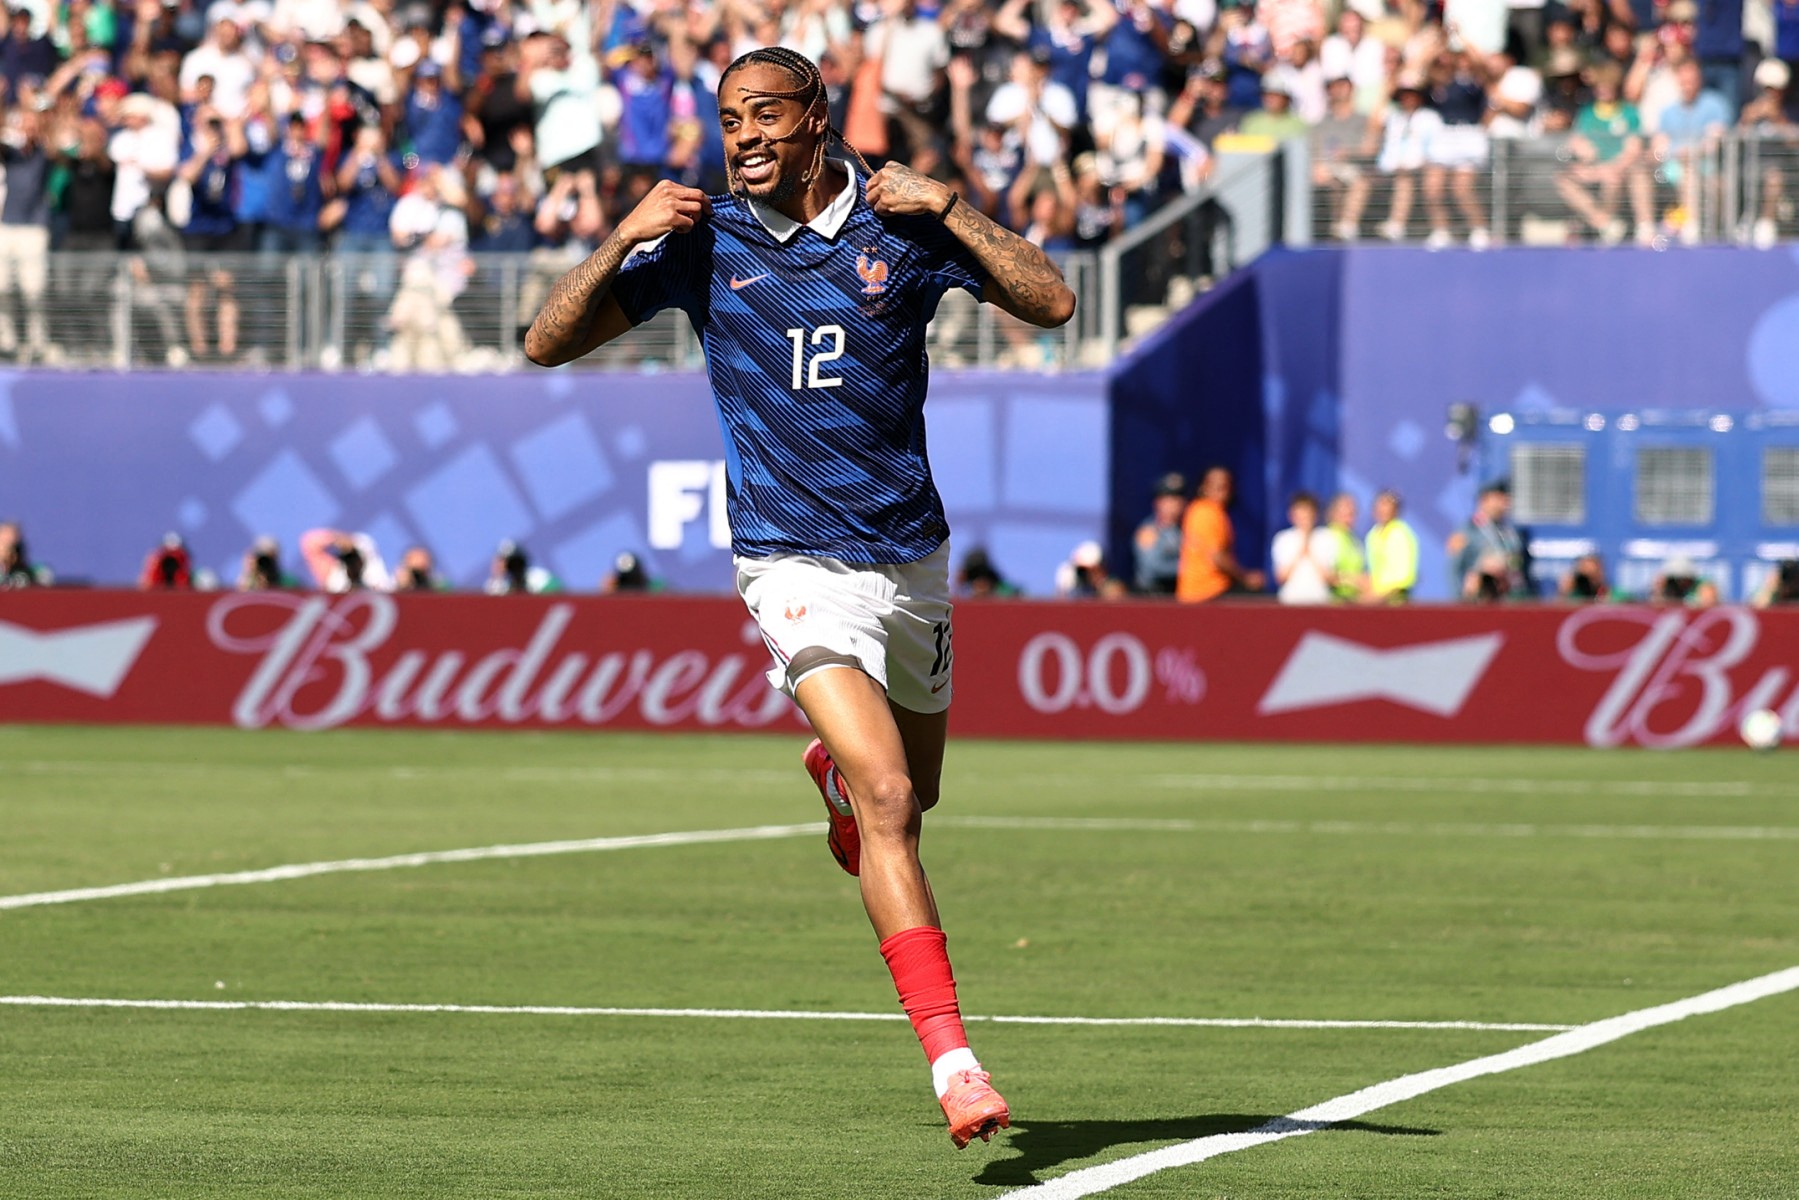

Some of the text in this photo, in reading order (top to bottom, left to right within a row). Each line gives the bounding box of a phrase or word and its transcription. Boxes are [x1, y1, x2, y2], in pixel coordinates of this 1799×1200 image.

[786, 324, 846, 390] 12
[647, 459, 733, 550] FI
[205, 589, 812, 730] Budweis
